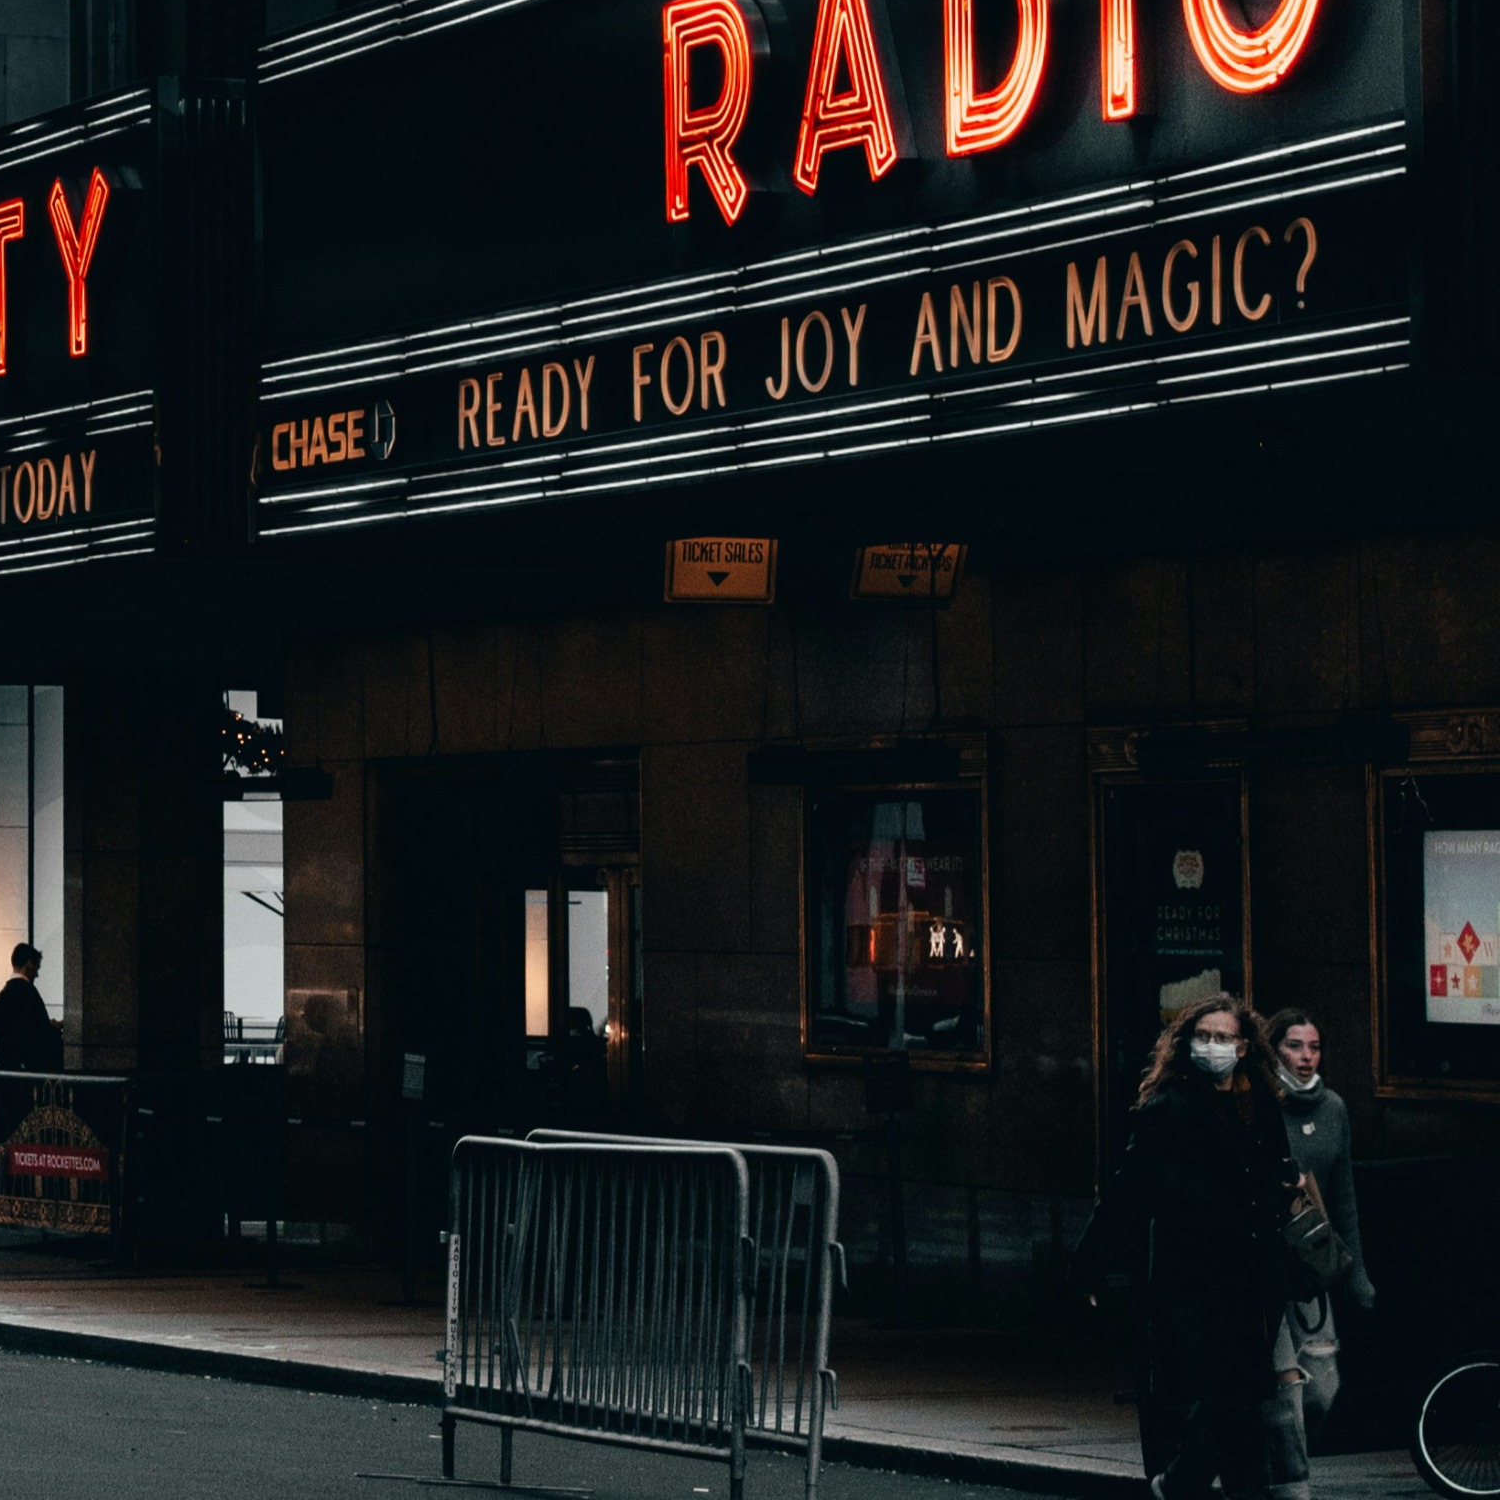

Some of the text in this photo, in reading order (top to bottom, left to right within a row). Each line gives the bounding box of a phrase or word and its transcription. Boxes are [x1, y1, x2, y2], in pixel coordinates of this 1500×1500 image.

[457, 216, 1319, 451] READY FOR JOY AND MAGIC?
[271, 408, 367, 472] CHASE
[681, 541, 764, 563] TICKET SALES
[870, 552, 906, 570] TICKET
[1157, 905, 1221, 920] READY FOR
[1157, 926, 1221, 941] CHRISTMAS
[14, 1151, 101, 1172] TICKETS AT ROCKETTES.COM
[452, 1237, 460, 1277] RADIO
